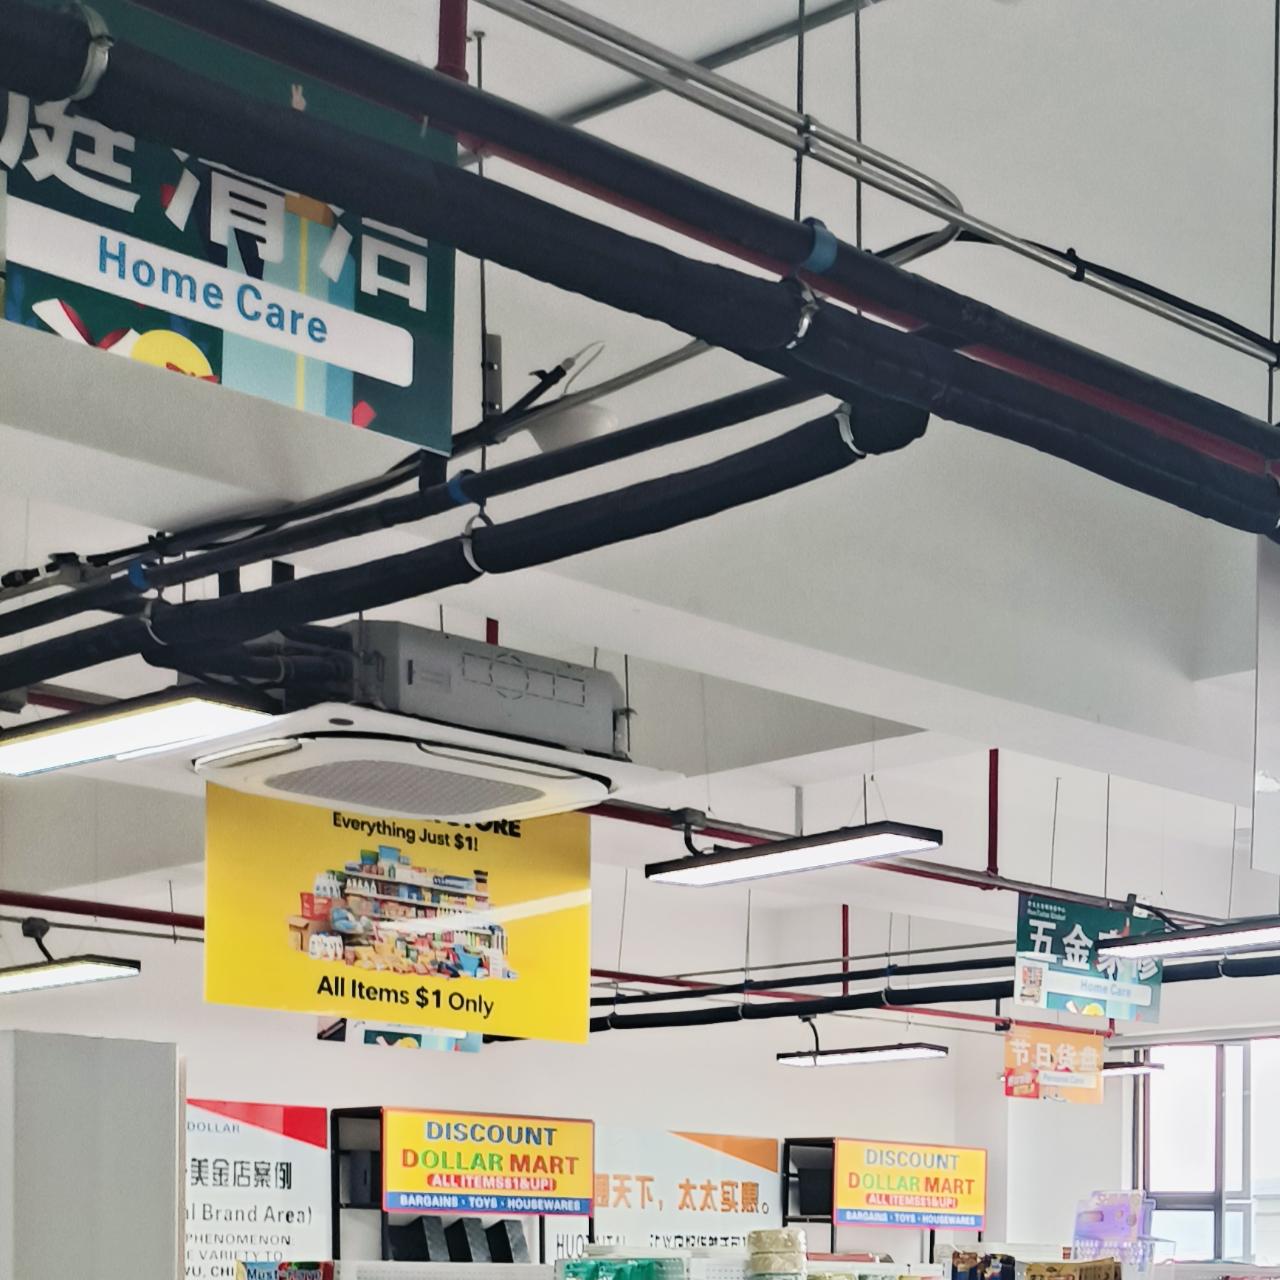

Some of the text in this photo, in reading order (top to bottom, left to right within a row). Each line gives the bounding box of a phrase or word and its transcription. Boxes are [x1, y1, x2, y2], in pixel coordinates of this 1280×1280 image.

[98, 236, 328, 345] Home Care
[333, 810, 479, 852] Everything Just $1!
[317, 975, 494, 1019] All Items $1 Only
[1081, 979, 1107, 995] Home
[186, 1121, 240, 1133] DOLLAR
[426, 1121, 558, 1146] DISCOUNT
[402, 1148, 579, 1175] DOLLAR MART
[865, 1148, 960, 1171] DISCOUNT
[431, 1174, 459, 1188] ALL
[848, 1172, 975, 1195] DOLLAR MART
[202, 1203, 257, 1223] Brand
[263, 1205, 313, 1224] Area)
[400, 1194, 581, 1212] BARGAINS TOYS HOUSEWARES
